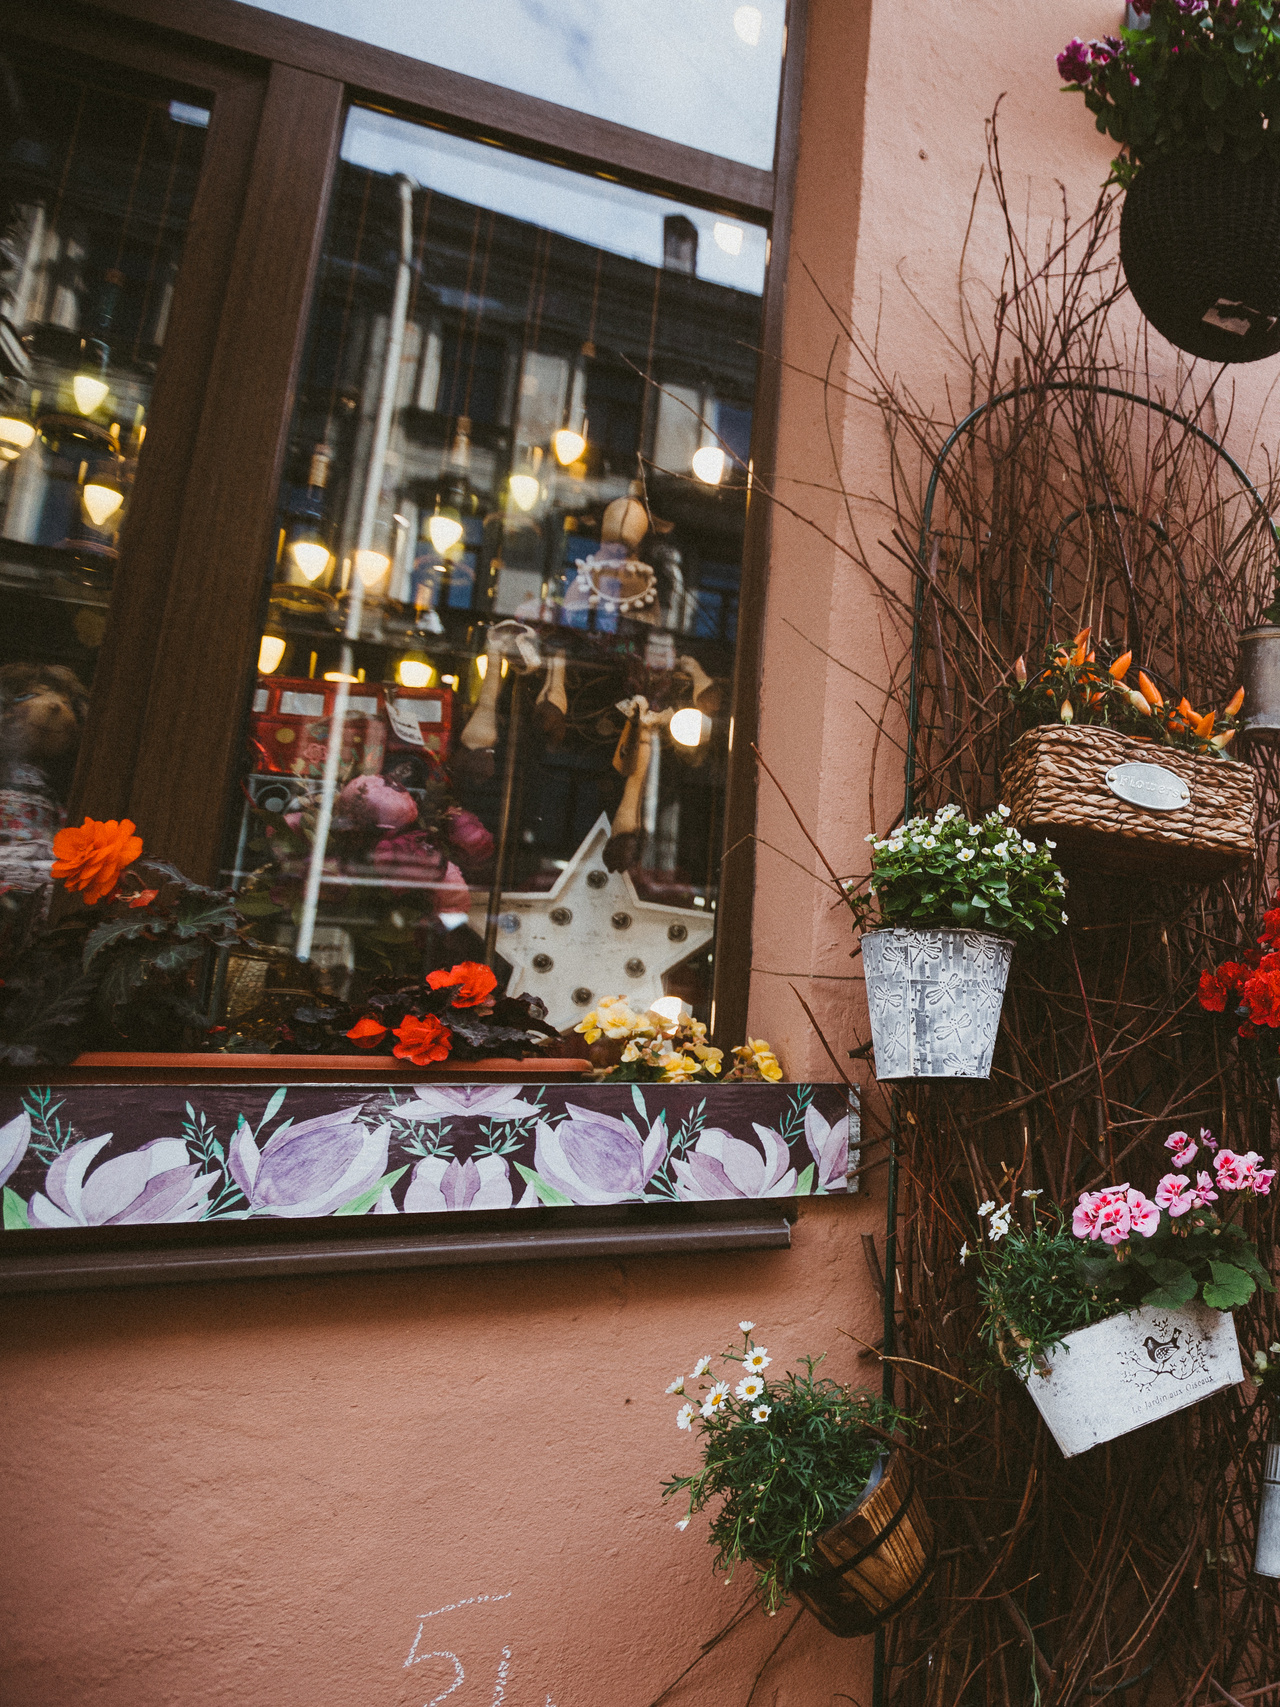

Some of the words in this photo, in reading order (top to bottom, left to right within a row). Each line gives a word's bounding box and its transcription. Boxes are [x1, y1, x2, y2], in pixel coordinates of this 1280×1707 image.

[1131, 1405, 1142, 1414] Le
[1144, 1393, 1168, 1411] Jardin
[1169, 1388, 1184, 1400] aux
[1185, 1375, 1215, 1393] Oiseaux
